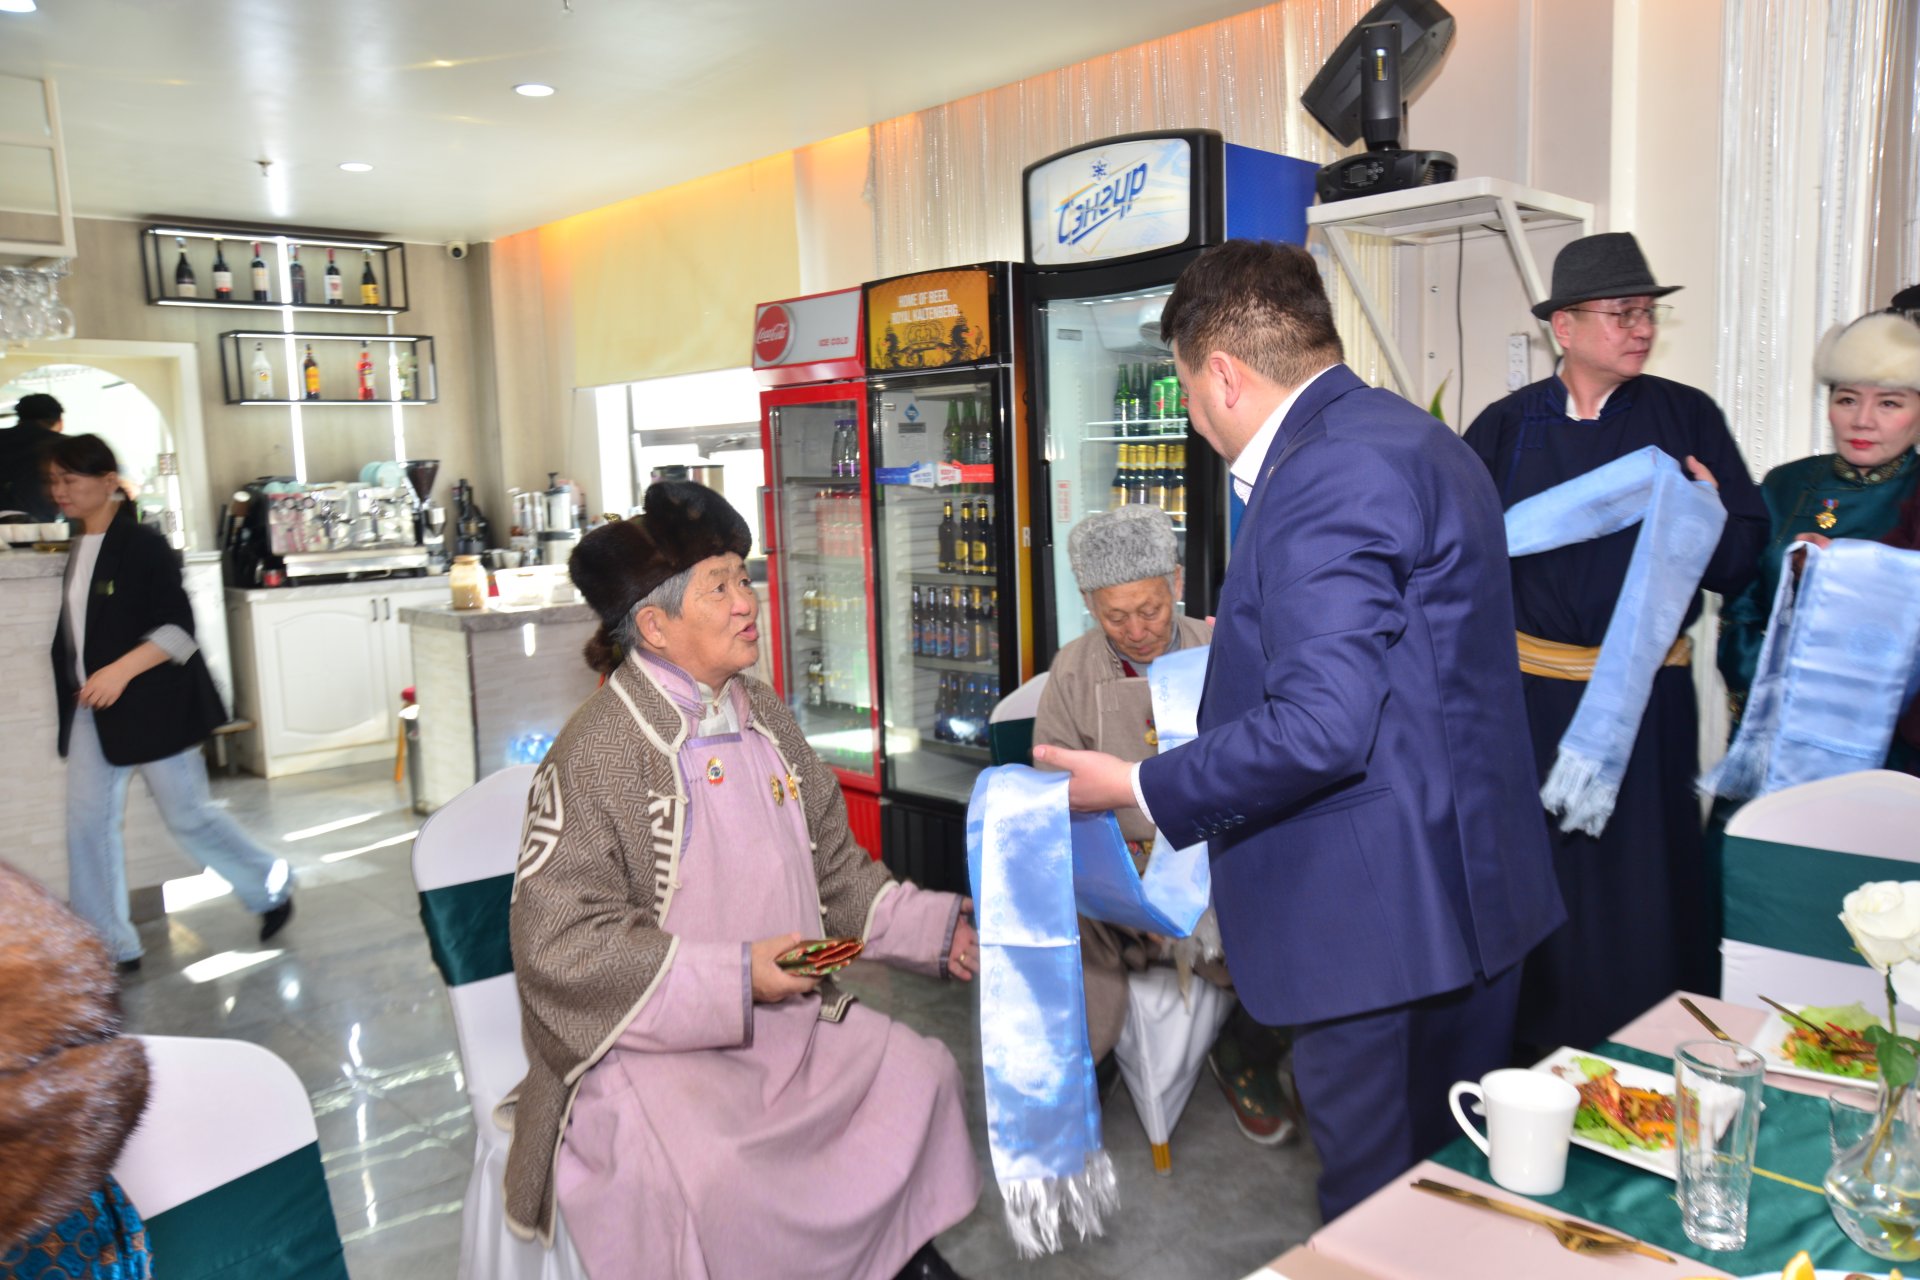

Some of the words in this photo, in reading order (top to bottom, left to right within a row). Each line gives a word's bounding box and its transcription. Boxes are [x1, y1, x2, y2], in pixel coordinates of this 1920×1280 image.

[898, 294, 918, 307] HOME
[891, 310, 912, 324] ROYAL
[757, 323, 788, 344] Coca-Cola
